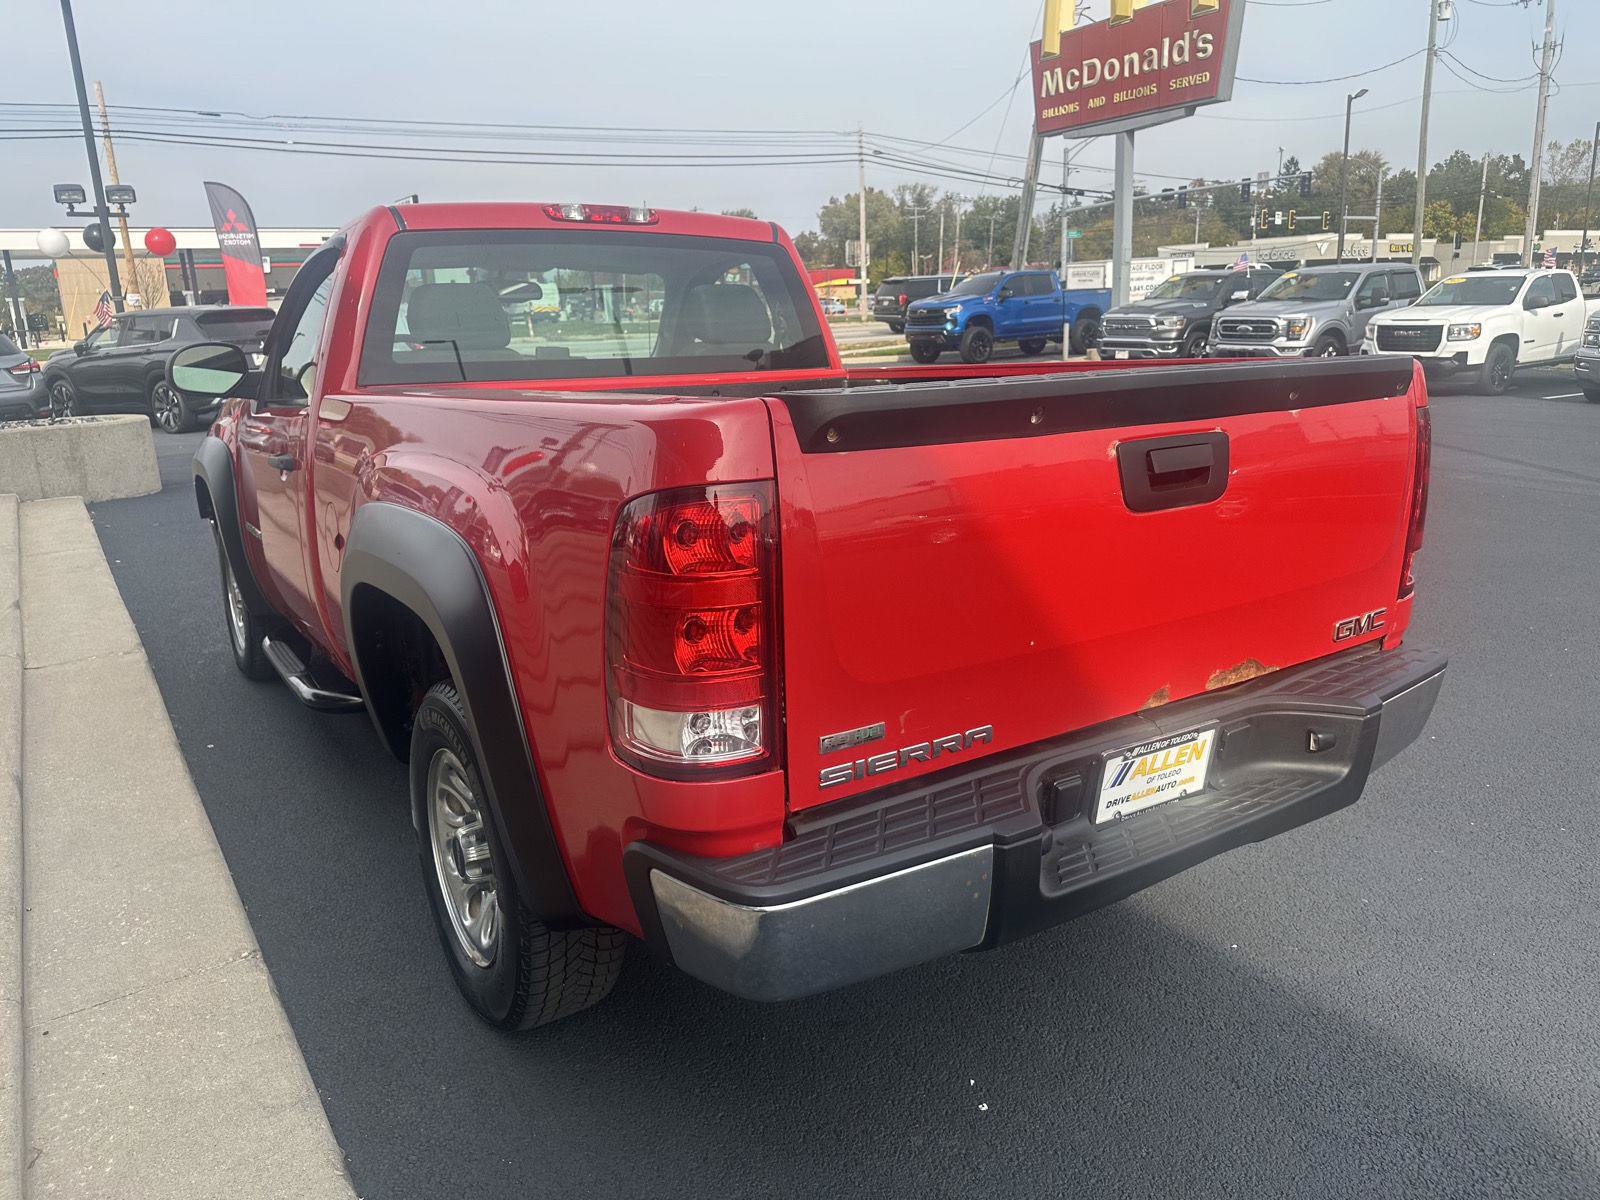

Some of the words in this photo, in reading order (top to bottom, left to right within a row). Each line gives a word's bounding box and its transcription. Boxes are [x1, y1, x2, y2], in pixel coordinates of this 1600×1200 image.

[1041, 30, 1214, 98] McDonald's
[1042, 102, 1079, 119] BILLIONS
[1087, 96, 1106, 109] AND
[1113, 83, 1157, 103] BILLIONS
[1169, 71, 1210, 90] SERVED
[1333, 607, 1387, 642] GMC
[819, 725, 993, 790] SIERRA
[1129, 739, 1207, 780] ALLEN
[1138, 741, 1161, 755] ALLEN
[1161, 739, 1170, 748] OF
[1170, 732, 1194, 745] TOLEDO
[1156, 768, 1182, 781] TOLEDO
